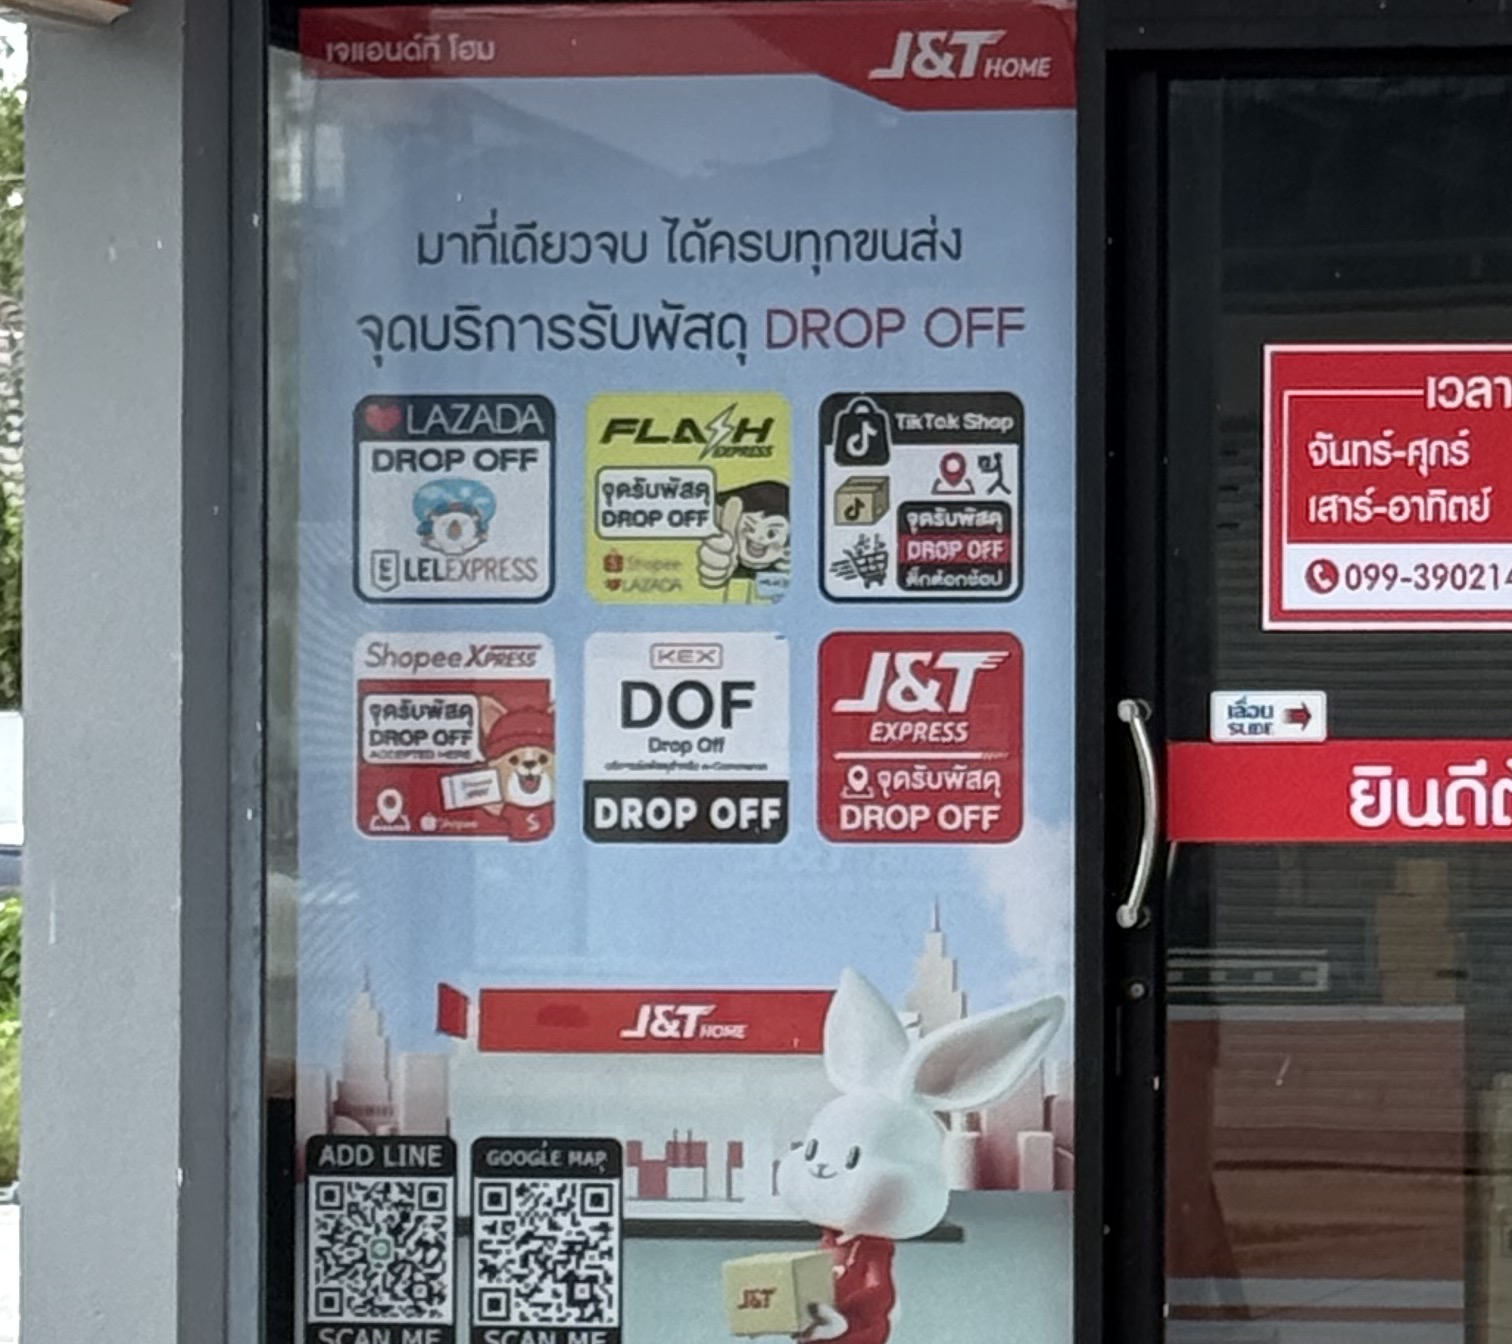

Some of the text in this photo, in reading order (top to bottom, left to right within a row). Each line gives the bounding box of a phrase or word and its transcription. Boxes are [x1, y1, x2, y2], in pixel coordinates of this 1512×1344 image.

[326, 32, 496, 63] เจแอนด์ที โฮม
[868, 29, 1050, 80] J&T HOME
[417, 207, 964, 276] มาที่เดียวจบ ได้ครบทุกขนส่ง
[355, 299, 1027, 369] จุดบริการรับพัสดุ DROP OFF
[407, 403, 546, 435] LAZADA
[895, 413, 1015, 433] TikTok Shop
[371, 448, 540, 472] DROP OFF
[1308, 428, 1471, 477] จันทร์-ศุกร์
[601, 509, 711, 528] DROP OFF
[1308, 486, 1493, 524] เสาร์-อาทิตย์
[907, 539, 1004, 559] DROP OFF
[365, 642, 463, 674] Shopee
[657, 649, 718, 664] KEX
[831, 651, 1009, 713] J&T
[620, 680, 756, 730] DOF
[368, 729, 473, 748] DROP OFF
[869, 721, 970, 743] EXPRESS
[1227, 723, 1274, 736] SLIDE
[648, 737, 726, 757] Drop Off
[877, 765, 1002, 798] จุดรับพัสดุ
[594, 797, 782, 831] DROP OFF
[839, 804, 1001, 831] DROP OFF
[619, 1004, 748, 1041] J&T HOME
[319, 1144, 443, 1169] ADD LINE
[485, 1150, 610, 1170] GOOGLE MAP
[737, 1287, 777, 1310] J&T
